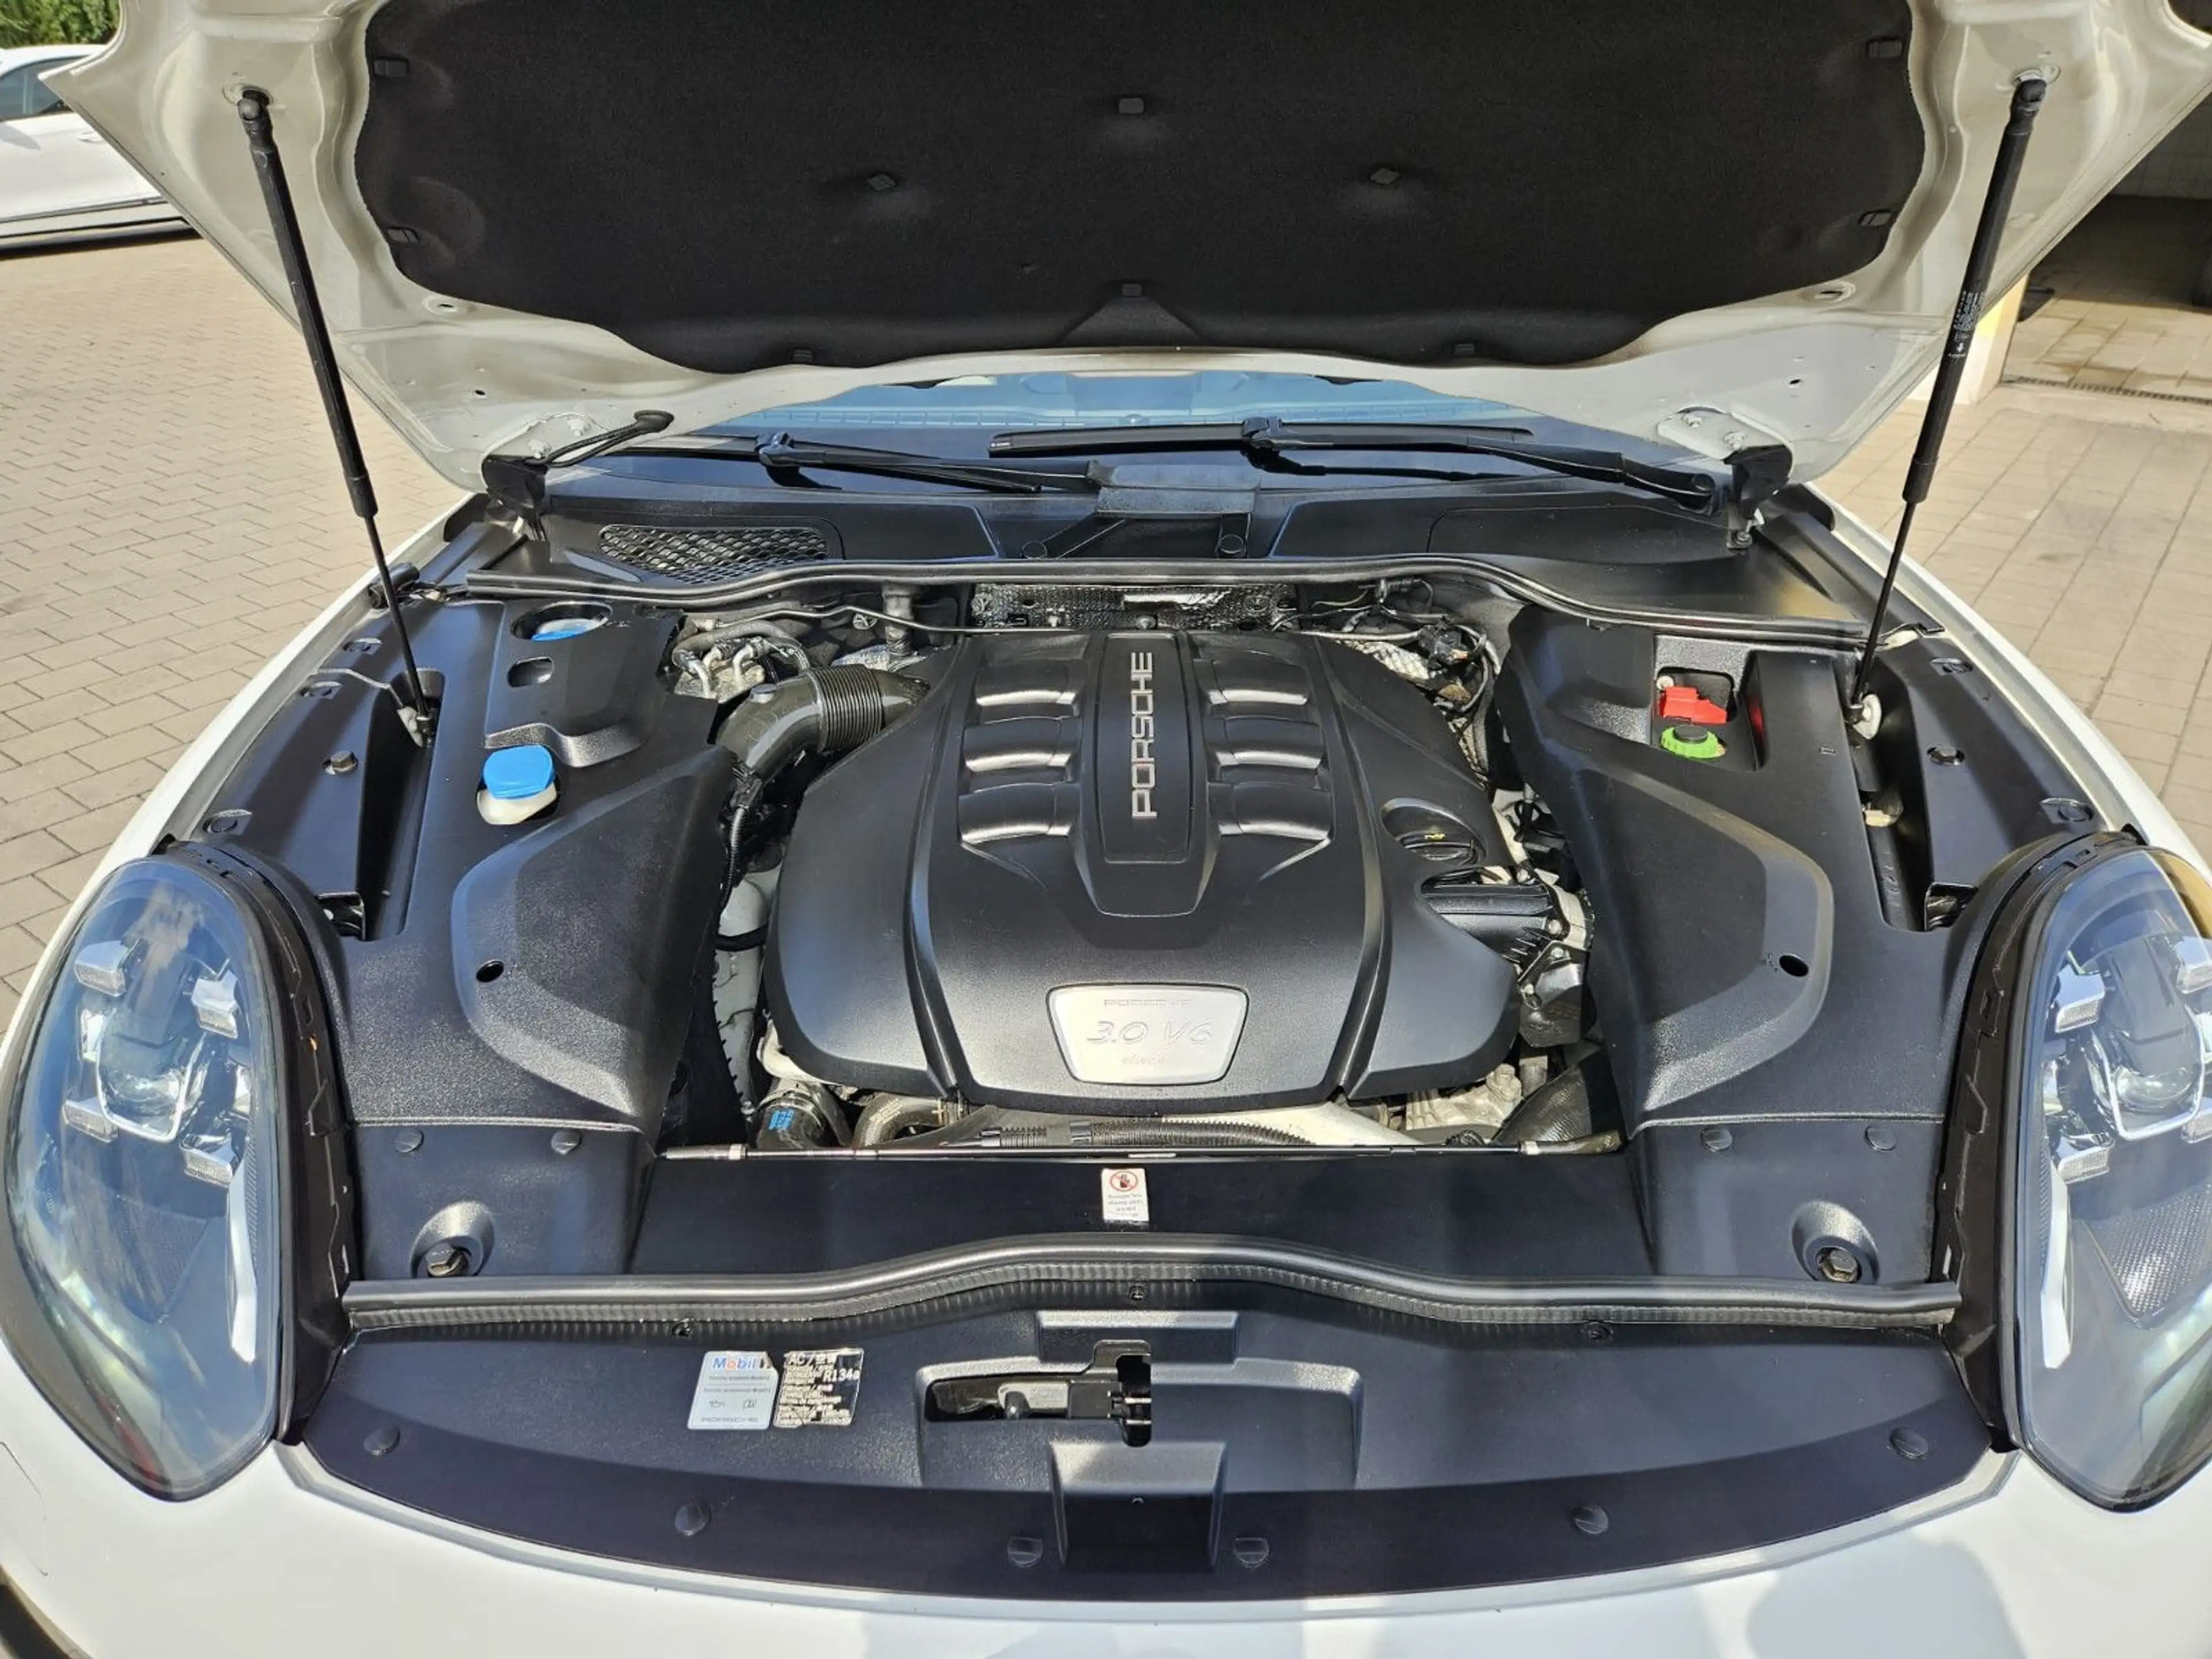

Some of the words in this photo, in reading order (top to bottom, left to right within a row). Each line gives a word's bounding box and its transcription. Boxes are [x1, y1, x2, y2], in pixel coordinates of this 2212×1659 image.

[1131, 652, 1157, 819] PORSCHE
[1086, 1021, 1149, 1044] 3.0
[1164, 1018, 1215, 1044] V6
[713, 1357, 756, 1370] Mobil
